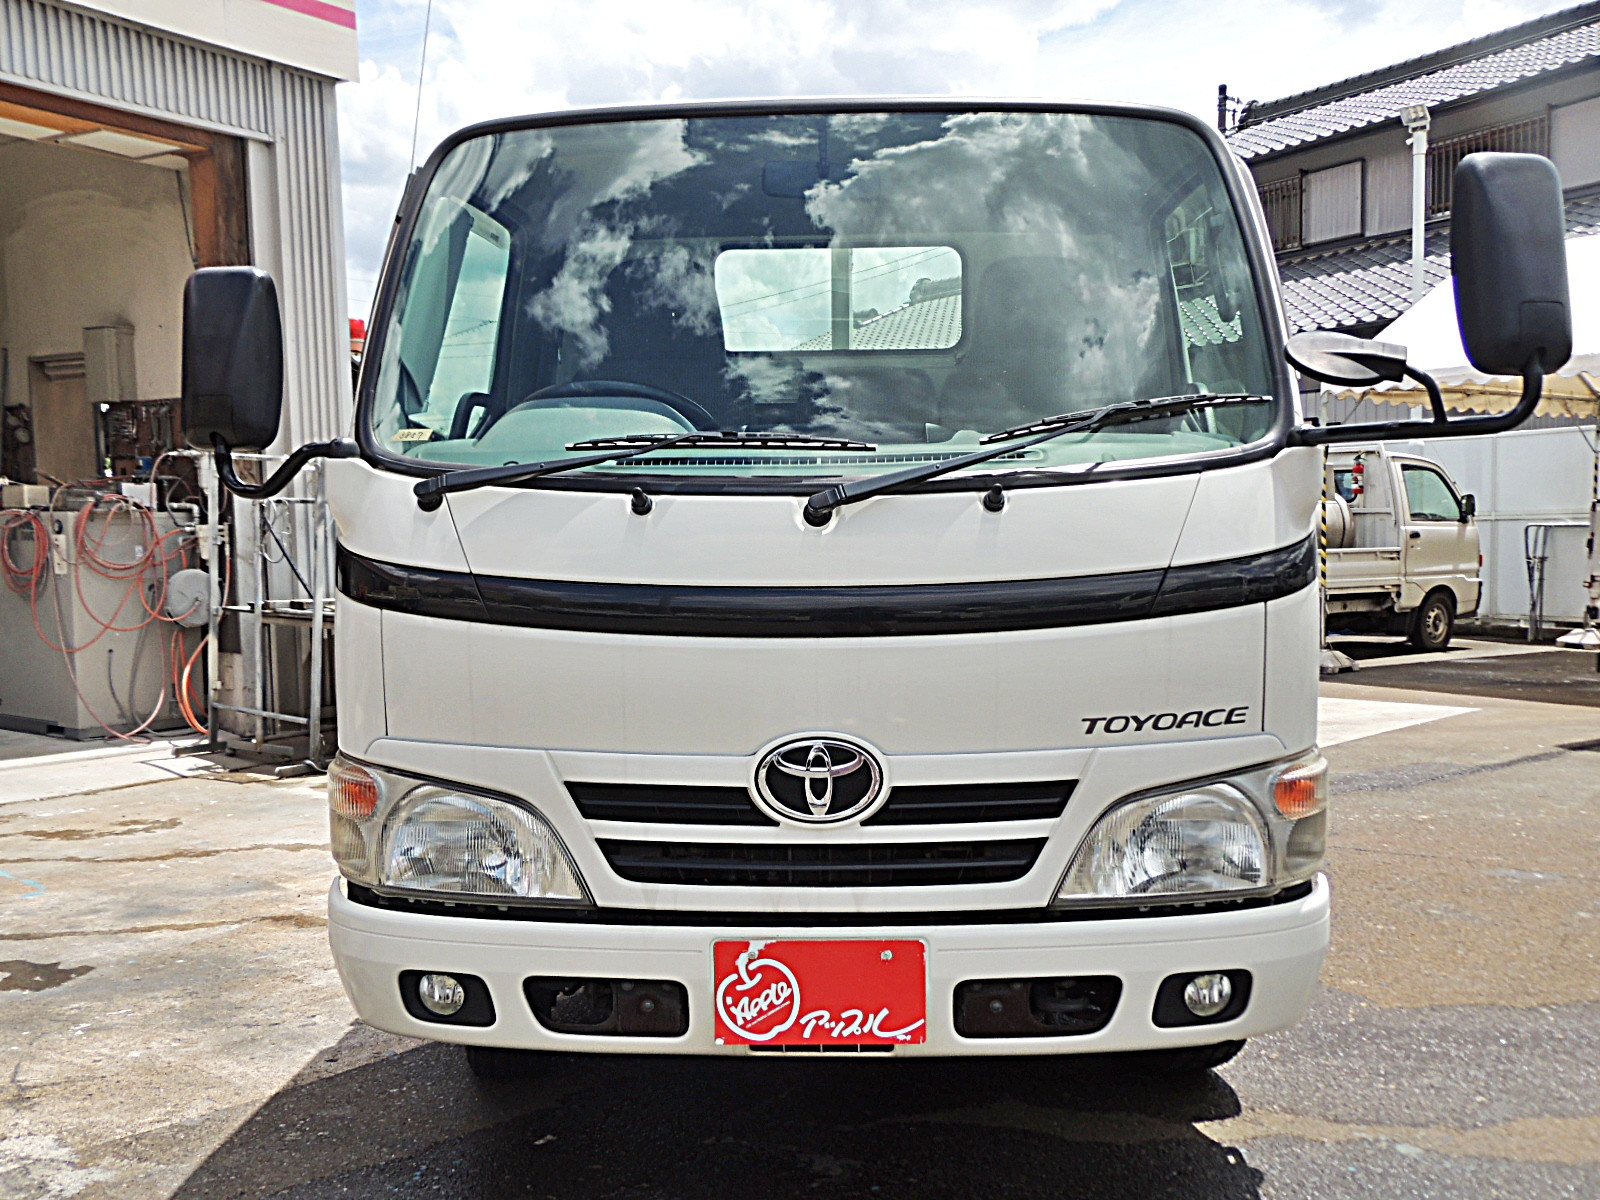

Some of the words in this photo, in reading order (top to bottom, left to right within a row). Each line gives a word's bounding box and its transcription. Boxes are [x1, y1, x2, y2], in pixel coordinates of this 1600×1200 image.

[1081, 706, 1249, 735] TOYOACE
[799, 1007, 925, 1038] アップル
